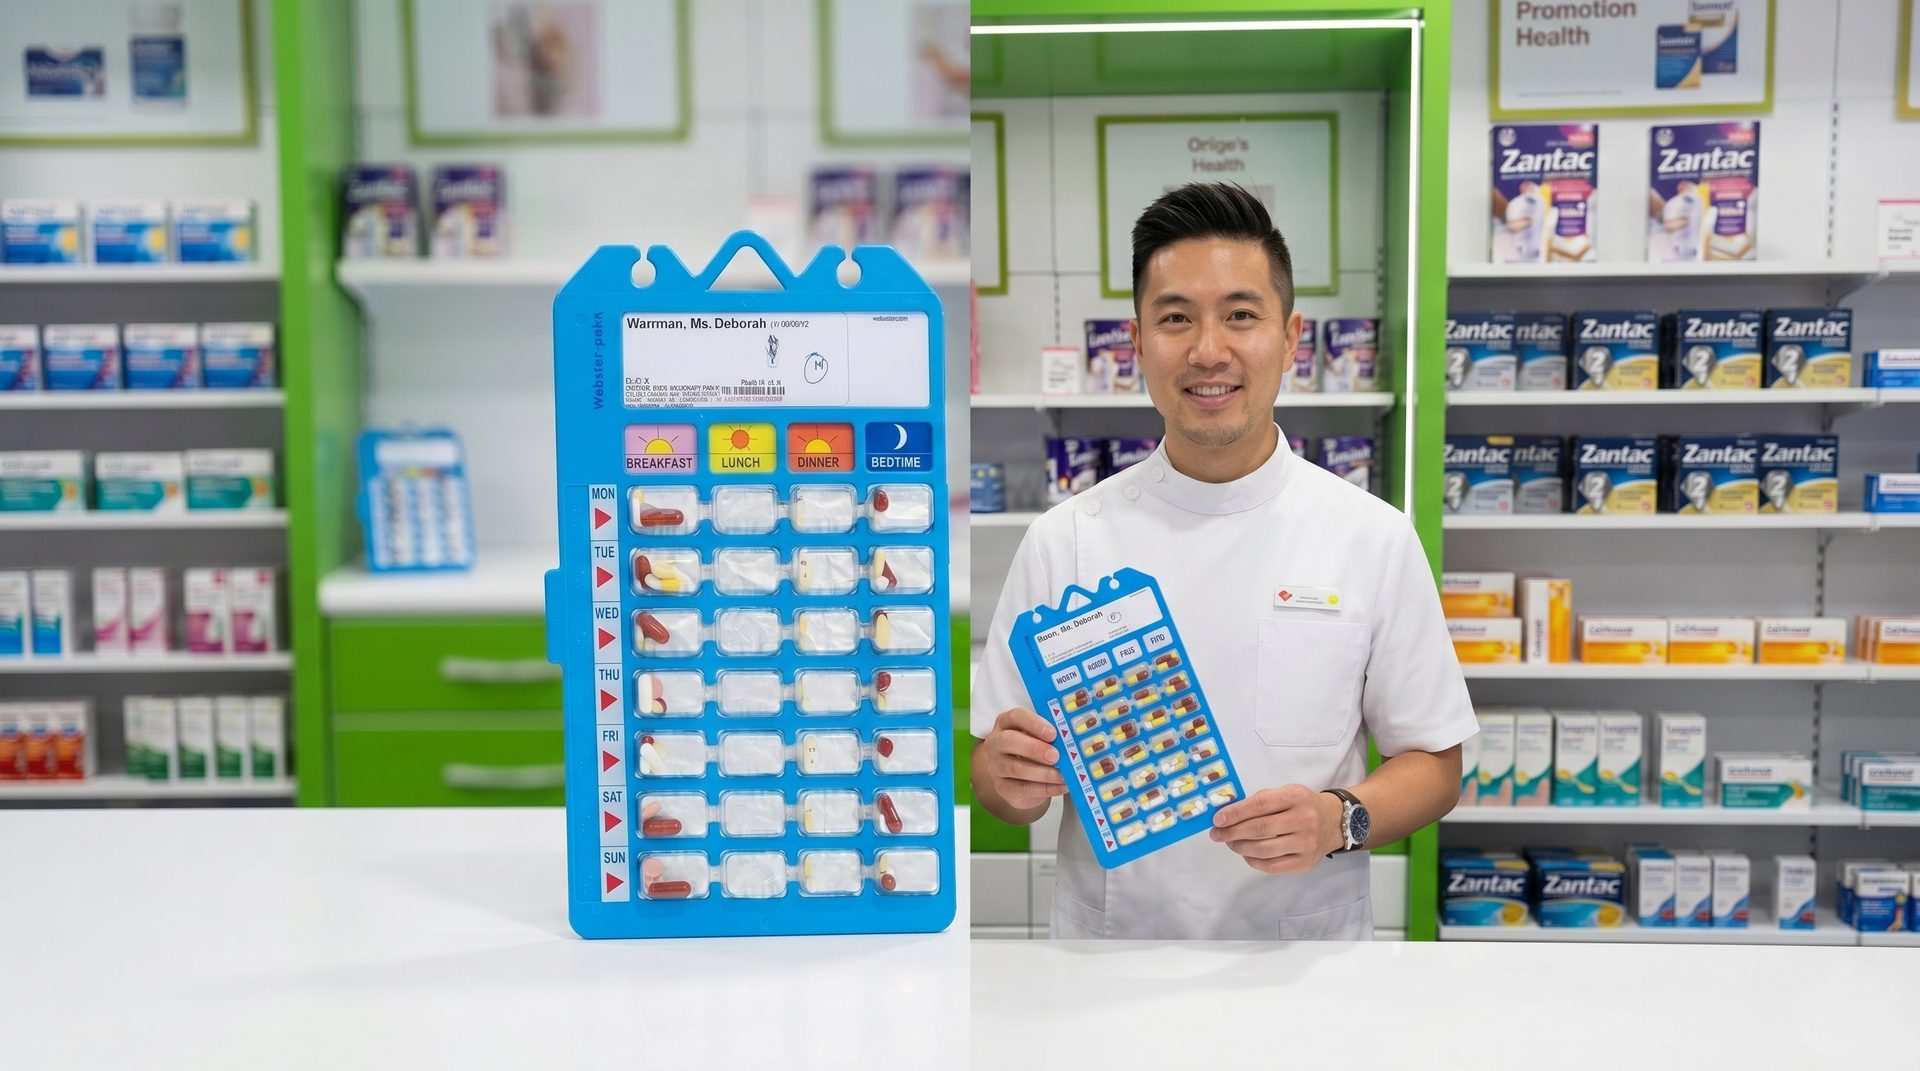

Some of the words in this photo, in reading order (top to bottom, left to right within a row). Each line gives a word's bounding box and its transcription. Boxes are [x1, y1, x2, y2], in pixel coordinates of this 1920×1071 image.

[1516, 1, 1637, 20] Promotion
[1516, 26, 1590, 46] Health
[1192, 158, 1245, 172] Health
[1499, 148, 1596, 173] Zantac
[1657, 145, 1756, 173] Zantac
[627, 318, 687, 331] Warrman,
[690, 318, 712, 329] Ms.
[714, 318, 766, 329] Deborah
[1445, 320, 1514, 339] Zantac
[1516, 322, 1562, 340] ntac
[1580, 319, 1656, 339] Zantac
[1684, 317, 1760, 337] Zantac
[1773, 317, 1849, 337] Zantac
[1513, 446, 1559, 462] ntac
[1579, 443, 1655, 463] Zantac
[1682, 443, 1758, 463] Zantac
[1761, 443, 1836, 462] Zantac
[627, 457, 692, 469] BREAKFAST
[721, 457, 760, 468] LUNCH
[797, 457, 839, 468] DINNER
[871, 457, 921, 468] BEDTIME
[592, 488, 615, 499] MON
[595, 546, 615, 558] TUE
[595, 607, 618, 619] WED
[599, 669, 620, 680] THU
[602, 730, 618, 742] FRI
[603, 791, 622, 802] SAT
[604, 852, 626, 863] SUN
[1447, 874, 1525, 893] Zantac
[1543, 875, 1621, 895] Zantac
